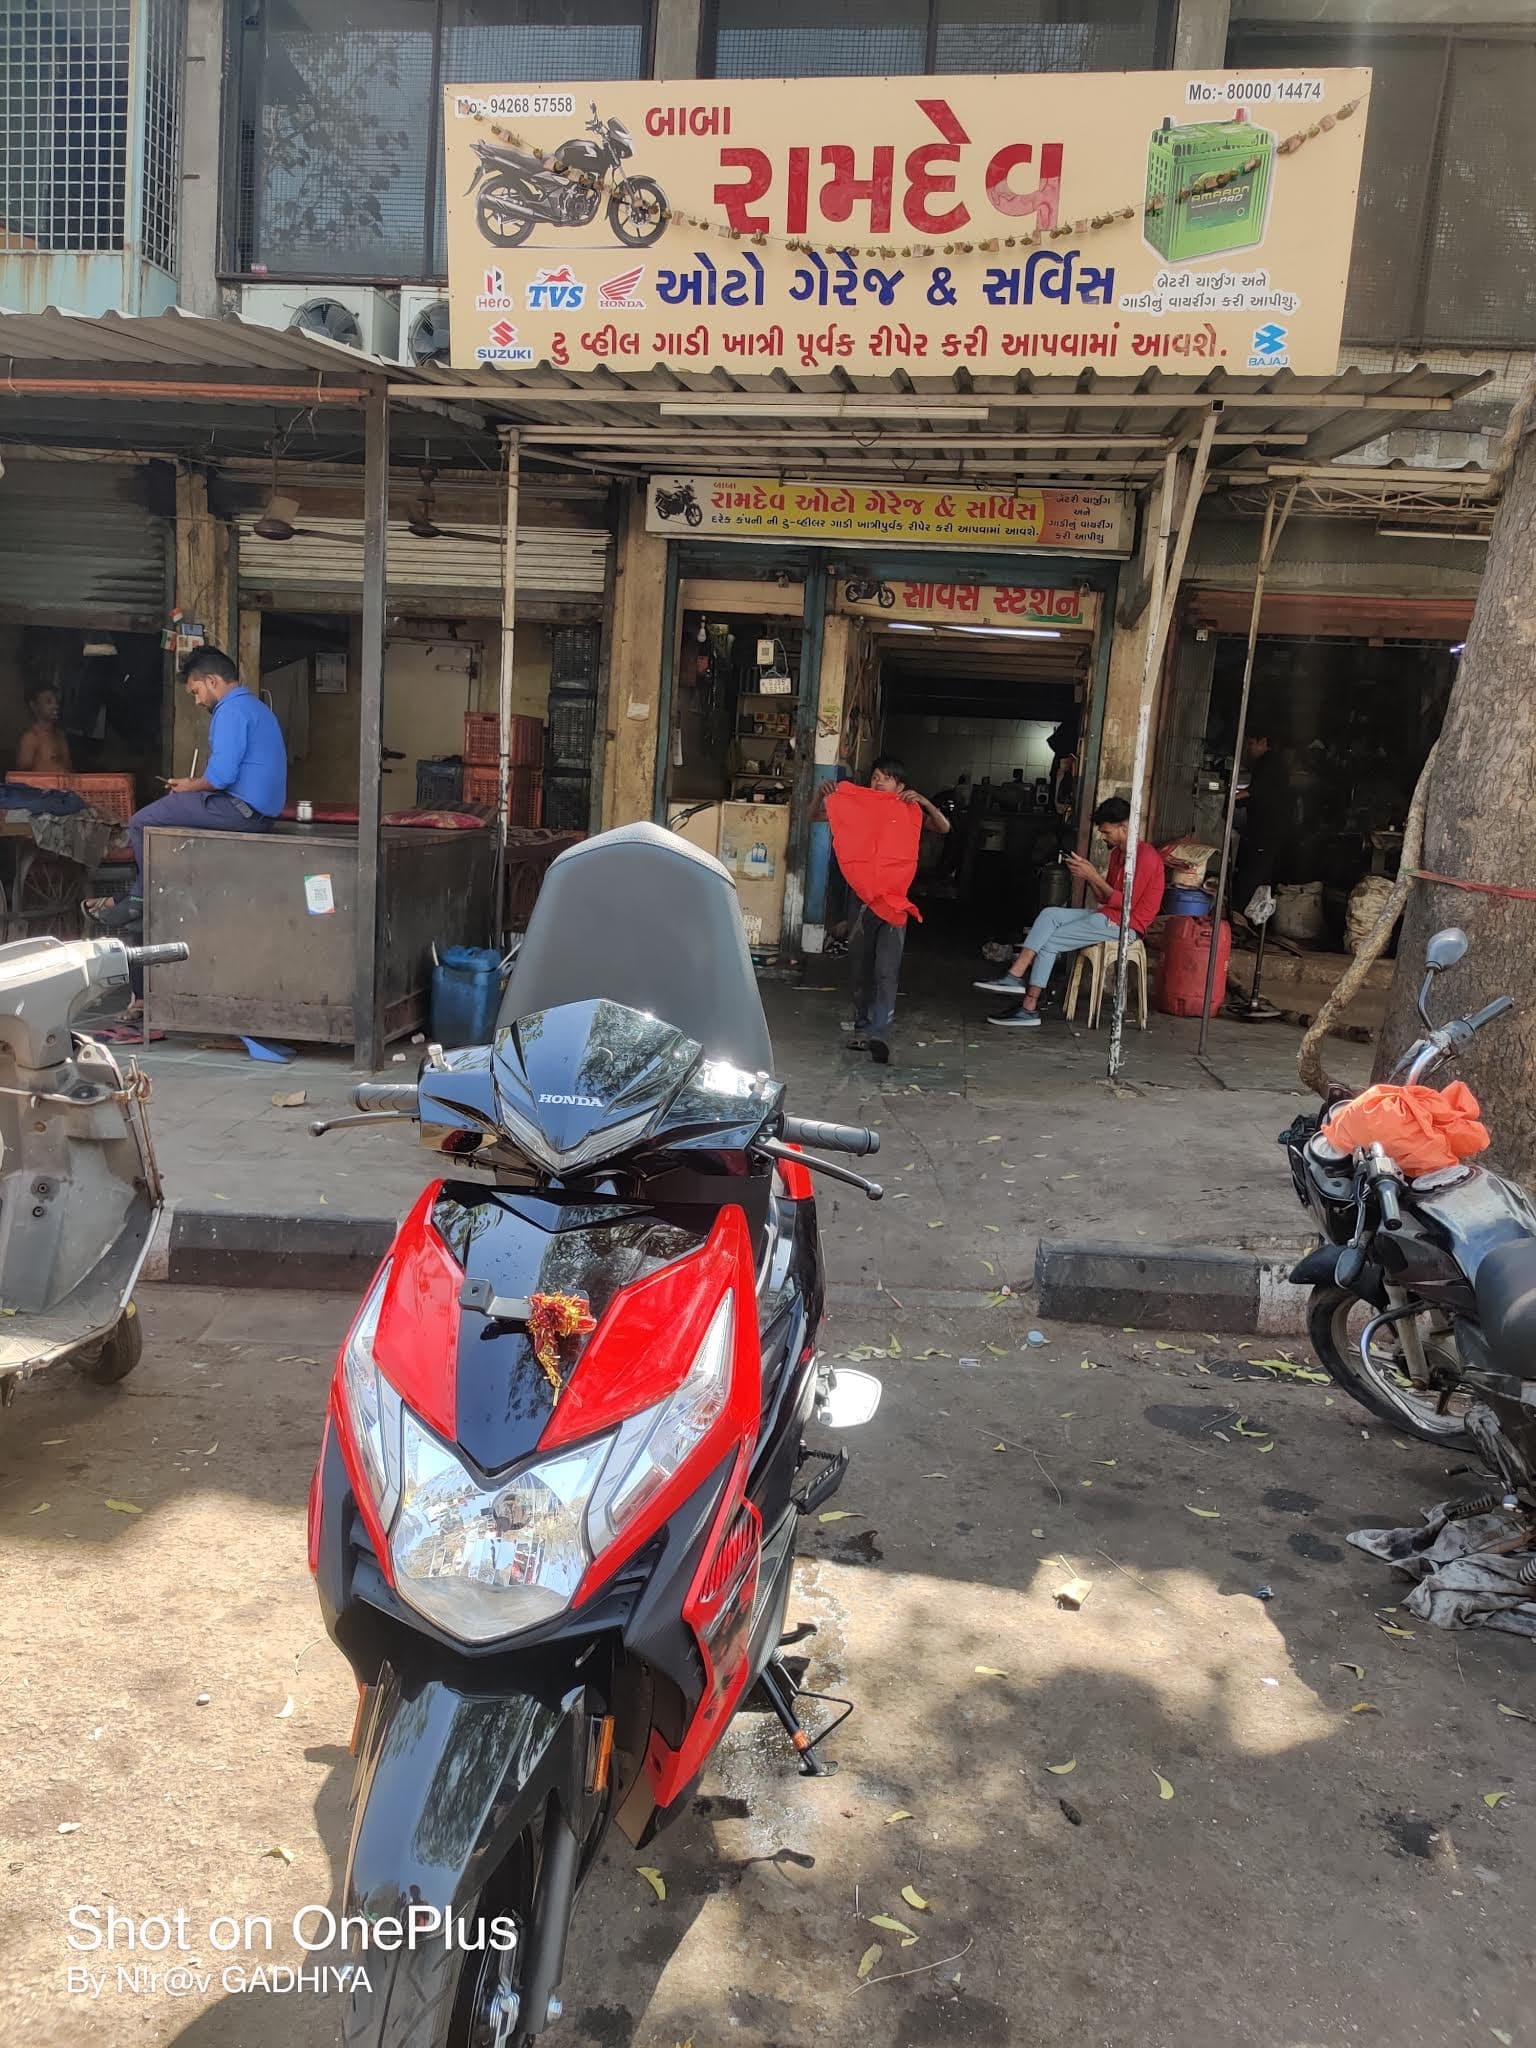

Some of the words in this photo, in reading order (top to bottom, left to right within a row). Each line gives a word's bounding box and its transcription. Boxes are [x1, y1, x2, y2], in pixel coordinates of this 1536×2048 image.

[1188, 83, 1223, 101] Mo:-
[1226, 83, 1272, 100] 80000
[1276, 82, 1321, 99] 14474
[490, 98, 530, 114] 94268
[533, 97, 573, 113] 57558
[645, 106, 731, 137] બાબા
[713, 99, 1064, 235] રામદેવ
[656, 252, 765, 307] ઓટો
[789, 248, 905, 307] ગેરેજ
[926, 266, 958, 306] &
[982, 249, 1116, 305] સર્વિસ
[1157, 272, 1190, 288] બેટરી
[1241, 272, 1267, 287] અને
[478, 297, 511, 308] Hero
[528, 285, 584, 308] TVS
[600, 300, 644, 308] HONDA
[1122, 293, 1163, 313] ગાડીનું
[1222, 293, 1244, 308] કરી
[551, 331, 570, 365] ટુ
[580, 324, 640, 357] વ્હીલ
[652, 324, 709, 356] ગાડી
[722, 324, 784, 356] ખાત્રી
[796, 323, 855, 367] પૂર્વક
[868, 323, 928, 357] રીપેર
[940, 324, 989, 357] કરી
[1001, 321, 1120, 357] આપવામાં
[1131, 322, 1228, 357] આવશે.
[477, 349, 532, 360] SUZUKI
[1248, 357, 1289, 366] BAJAJ
[711, 485, 785, 511] રામદેવ
[794, 488, 856, 513] ઓટો
[865, 490, 924, 516] ગેરેજ
[934, 495, 956, 518] &
[966, 495, 1038, 521] સર્વિસ
[711, 513, 731, 524] દરેક
[830, 518, 852, 529] ગાડી
[936, 522, 953, 533] કરી
[538, 1093, 605, 1108] HONDA
